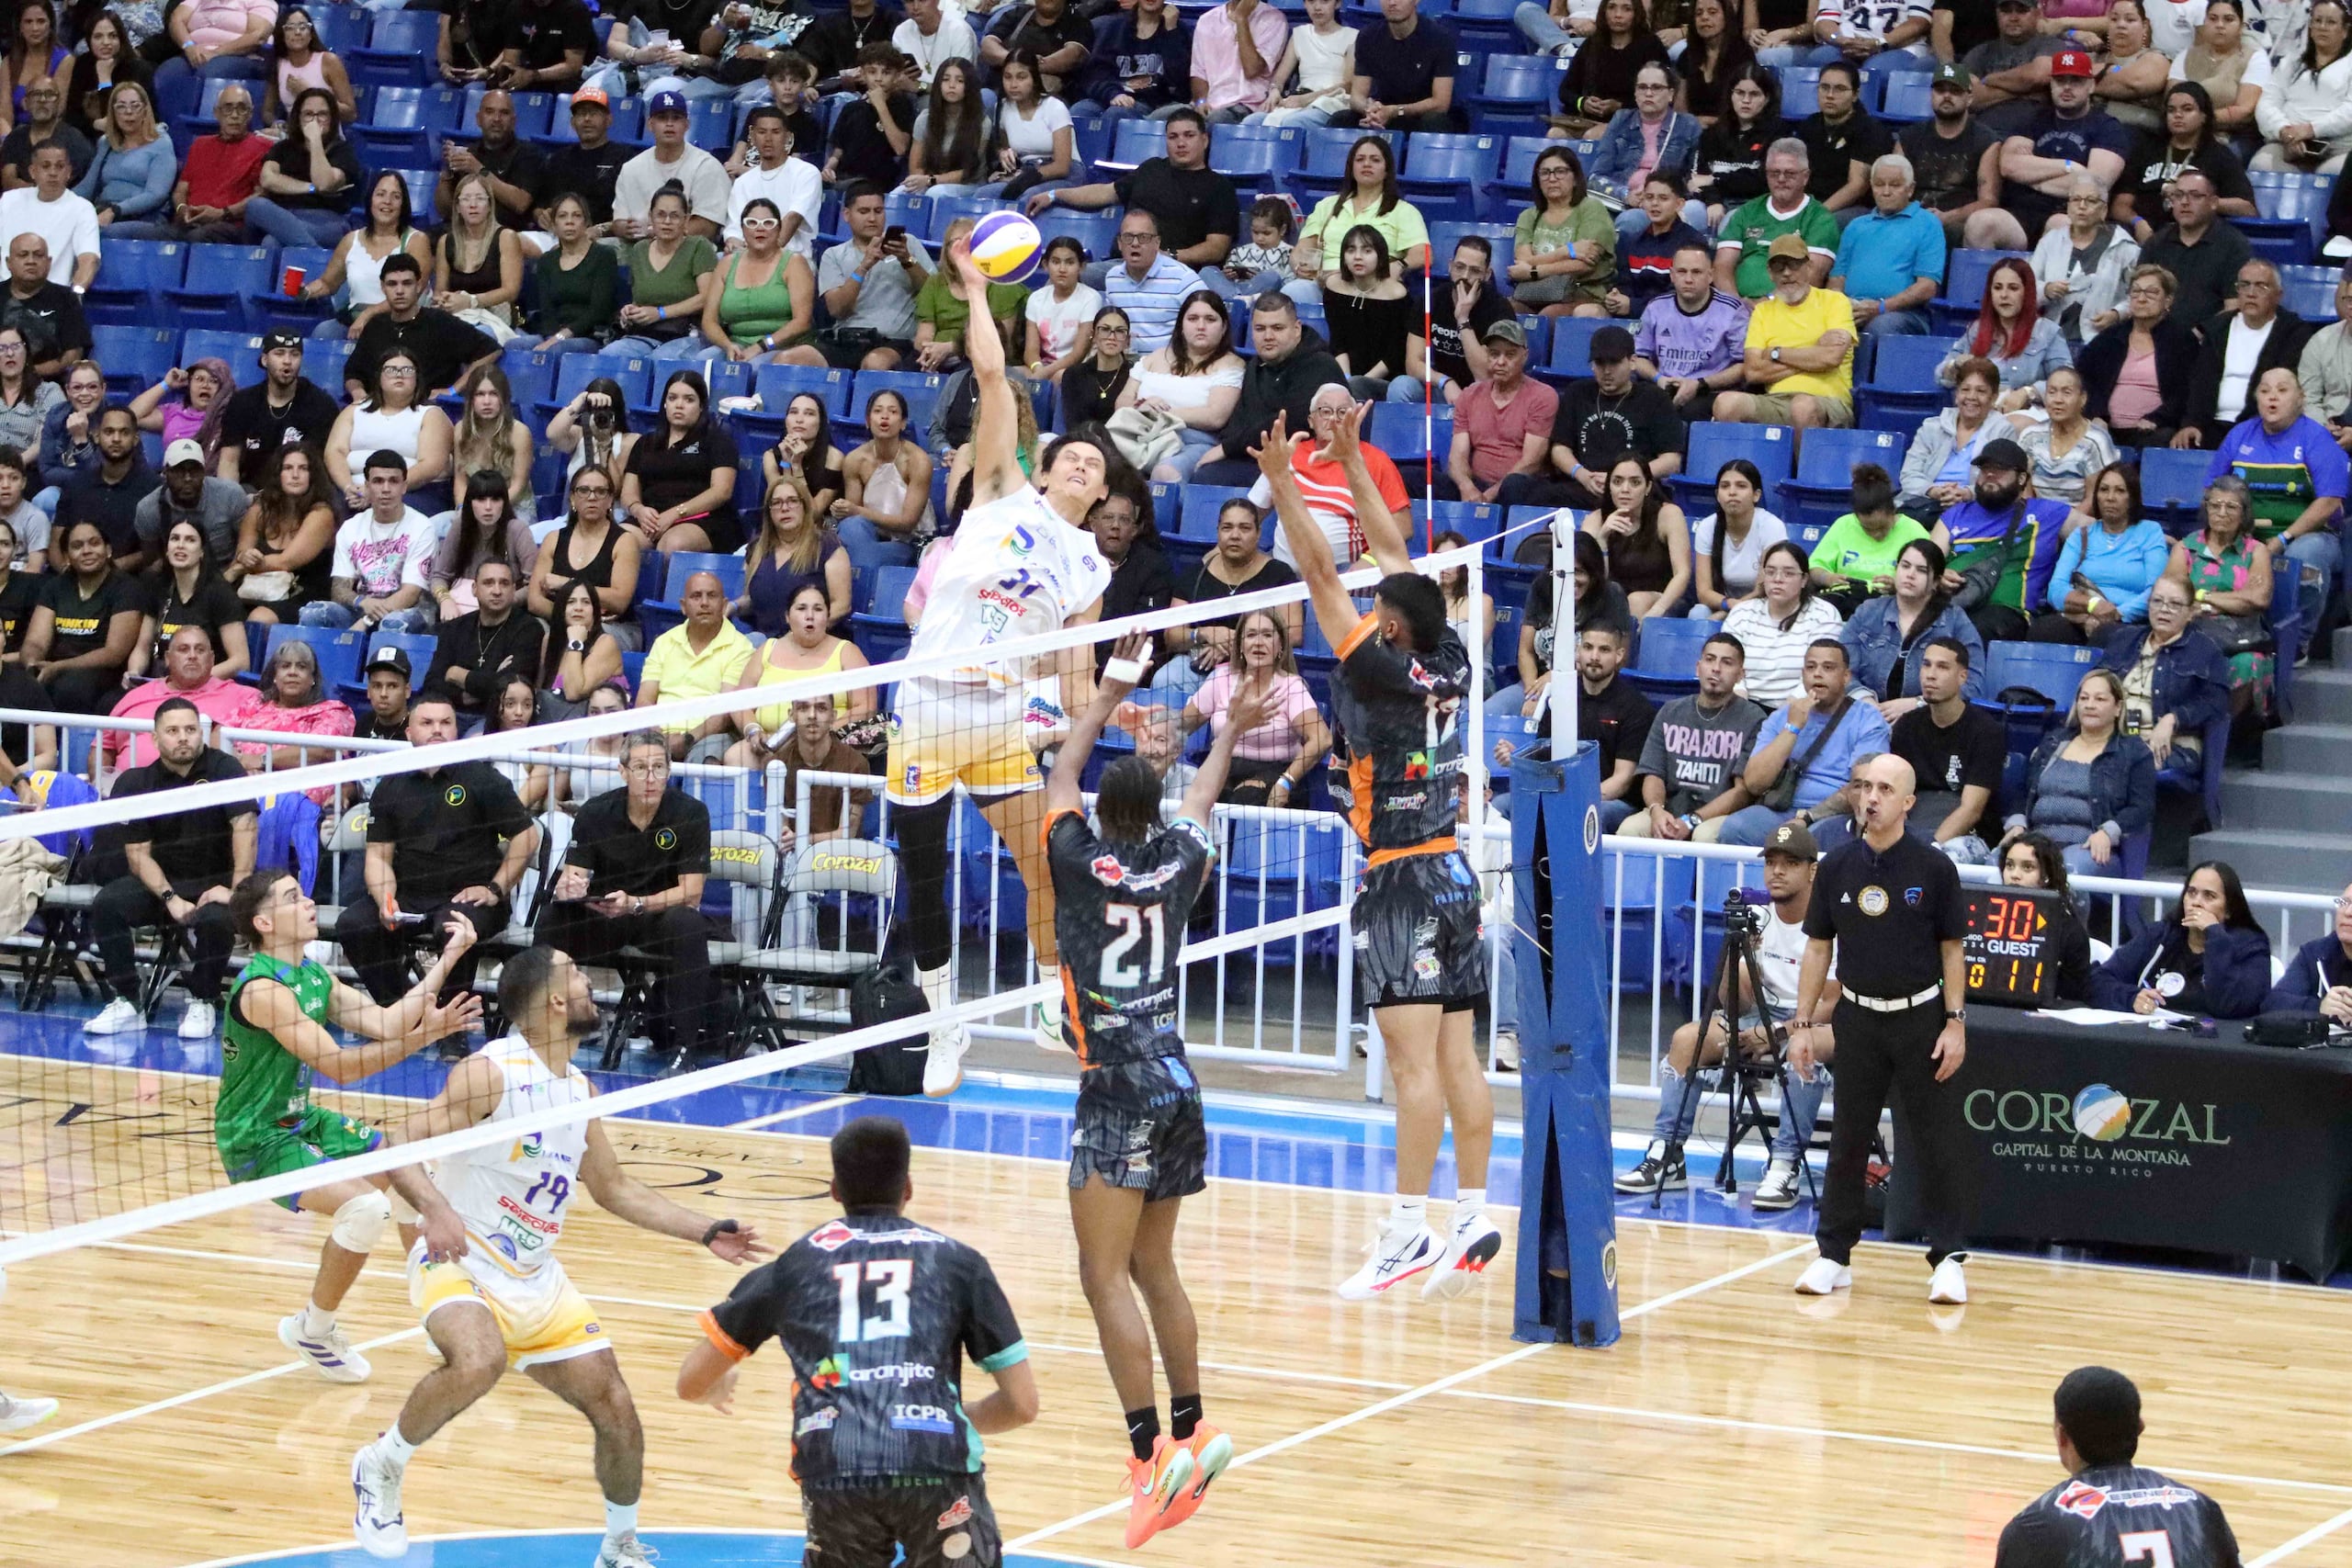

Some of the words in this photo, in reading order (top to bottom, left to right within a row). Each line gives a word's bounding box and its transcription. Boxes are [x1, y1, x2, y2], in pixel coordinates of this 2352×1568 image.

[663, 94, 674, 106] LA
[1657, 344, 1713, 361] Emirates
[1804, 527, 1818, 540] 25
[1496, 609, 1511, 622] 23
[1701, 729, 1744, 760] BORA
[1675, 759, 1722, 784] TAHITI
[710, 846, 764, 866] orozal
[811, 852, 883, 875] Corozal
[1100, 902, 1166, 989] 21
[1986, 939, 2041, 958] GUEST
[1968, 964, 1985, 988] 0
[1992, 1143, 2053, 1158] CAPITAL
[2059, 1145, 2078, 1159] DE
[2084, 1146, 2105, 1160] LA
[2110, 1148, 2192, 1168] MONTAÑA
[2024, 1163, 2095, 1175] PUERTO
[2109, 1167, 2153, 1179] RICO
[832, 1258, 914, 1343] 13
[895, 1404, 950, 1423] ICPR
